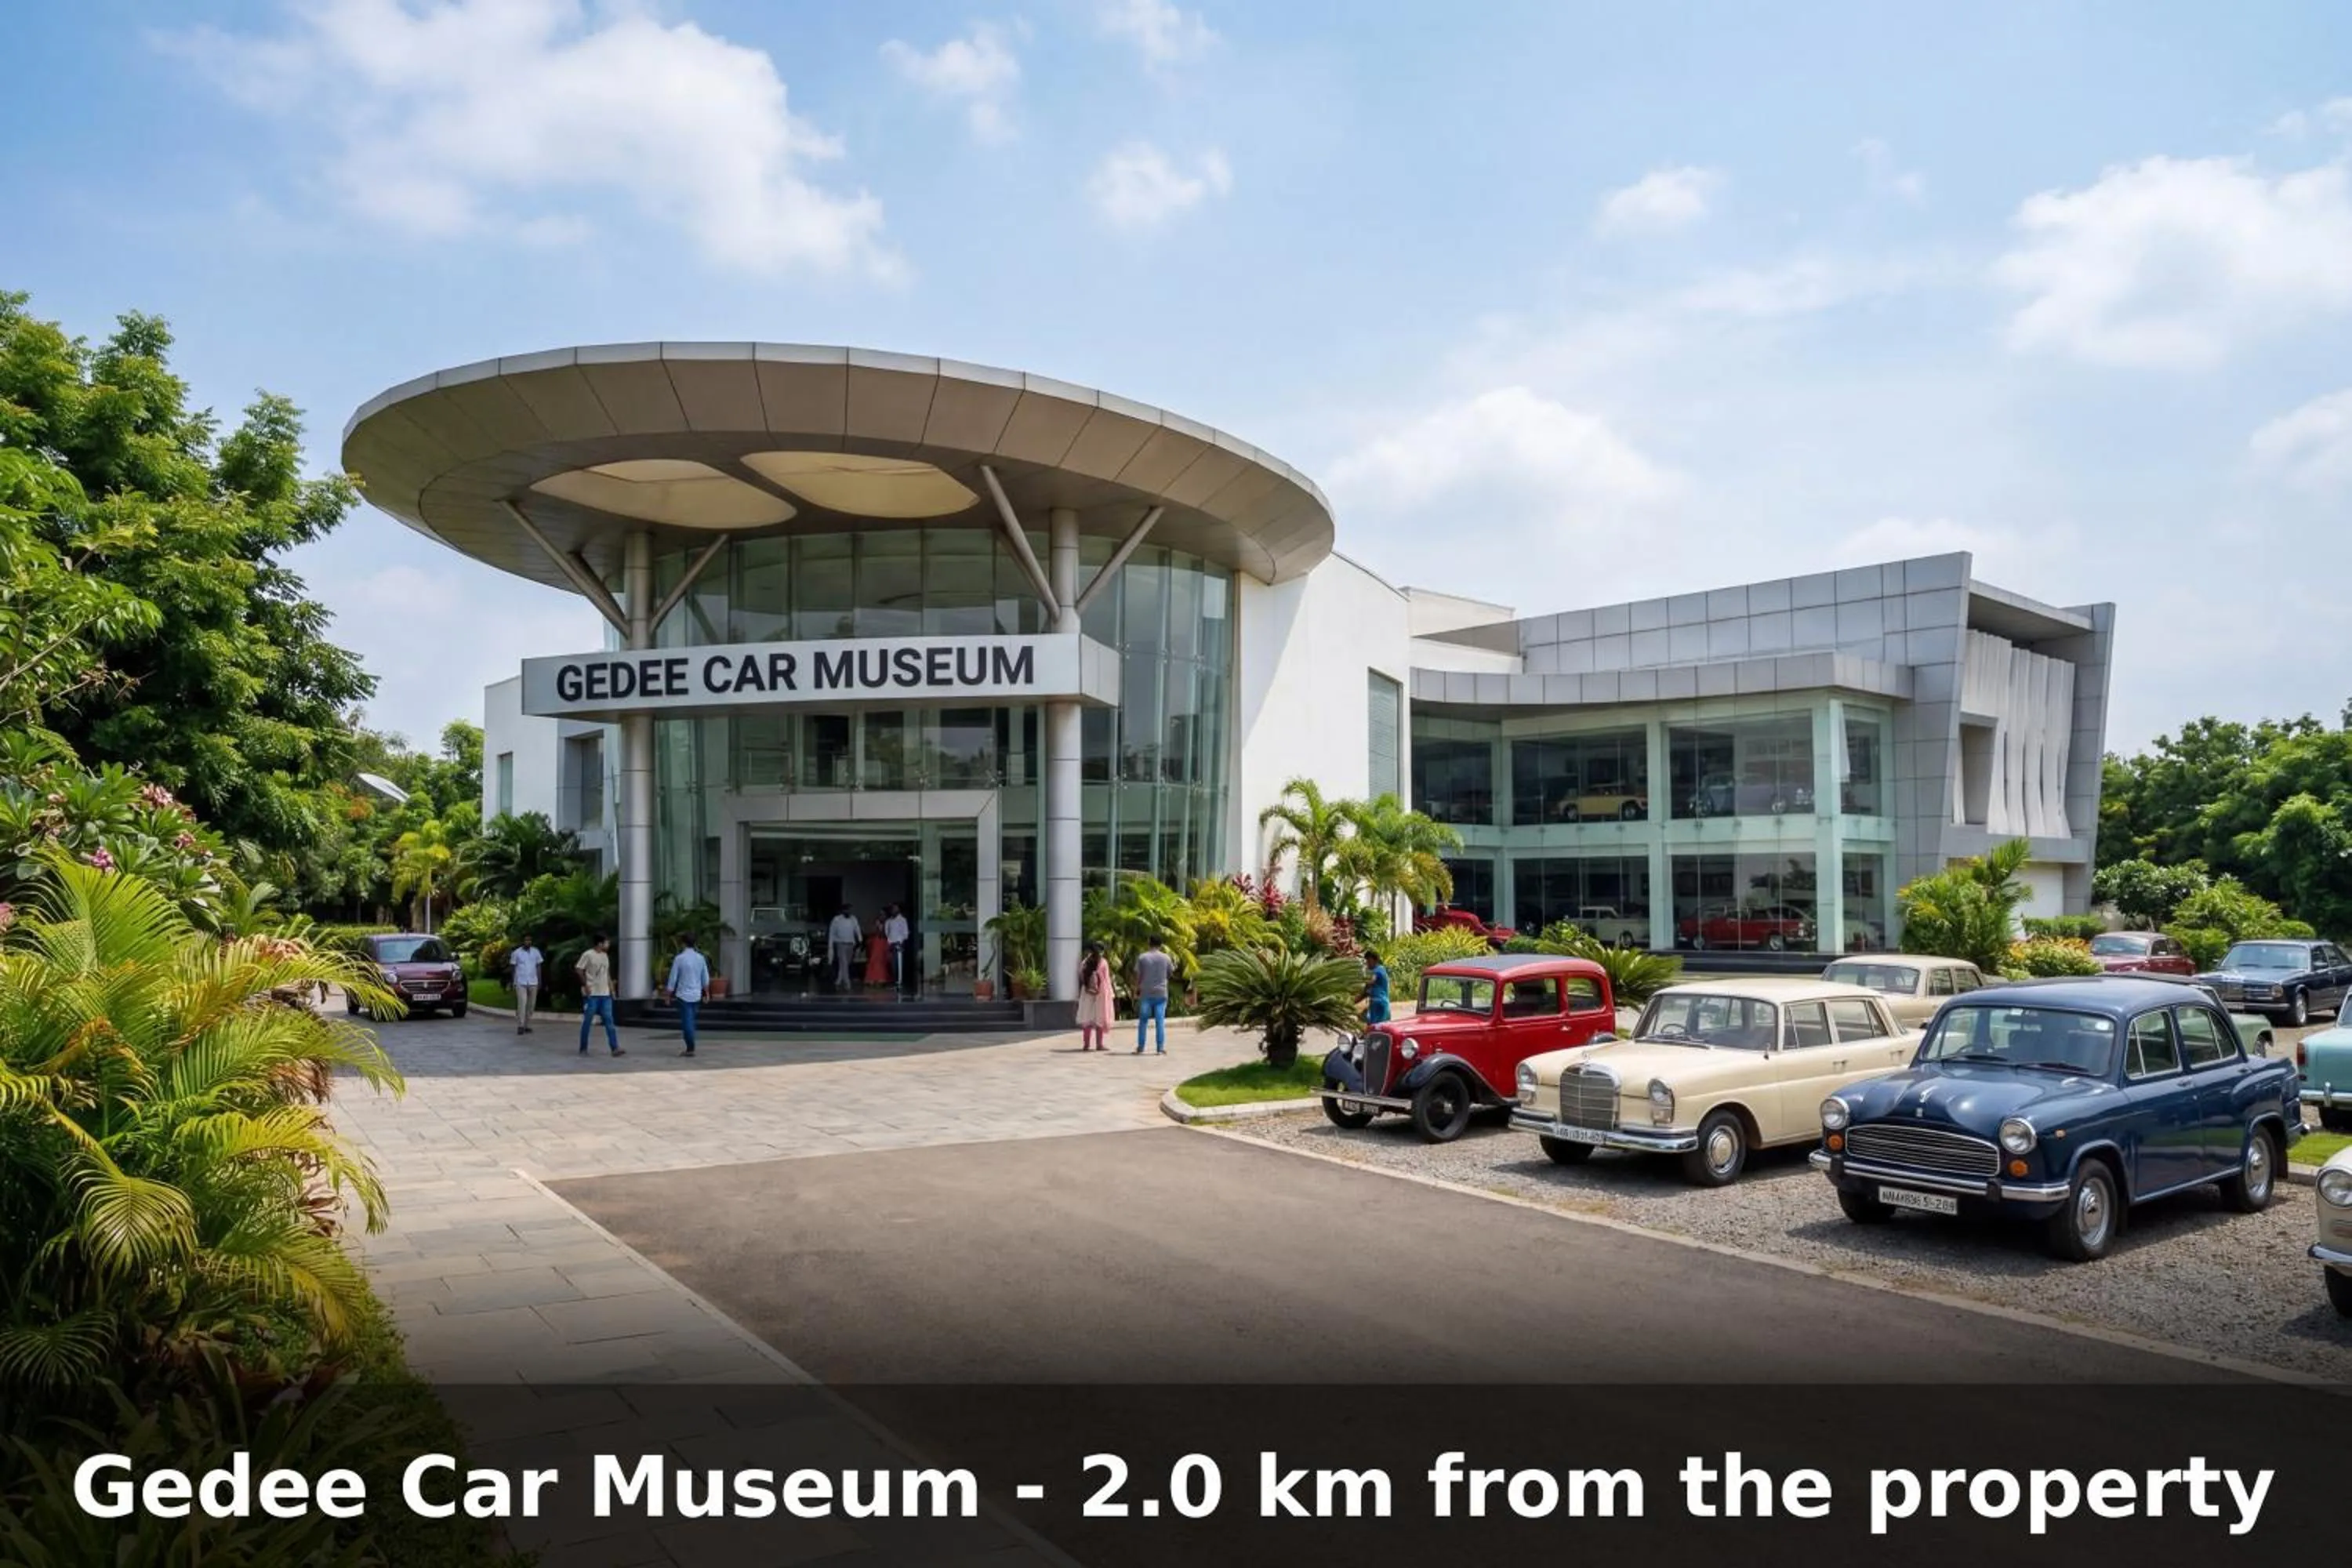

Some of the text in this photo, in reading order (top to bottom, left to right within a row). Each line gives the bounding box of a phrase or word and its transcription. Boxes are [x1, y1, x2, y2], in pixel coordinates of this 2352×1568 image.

[556, 645, 1034, 703] GEDEE CAR MUSEUM
